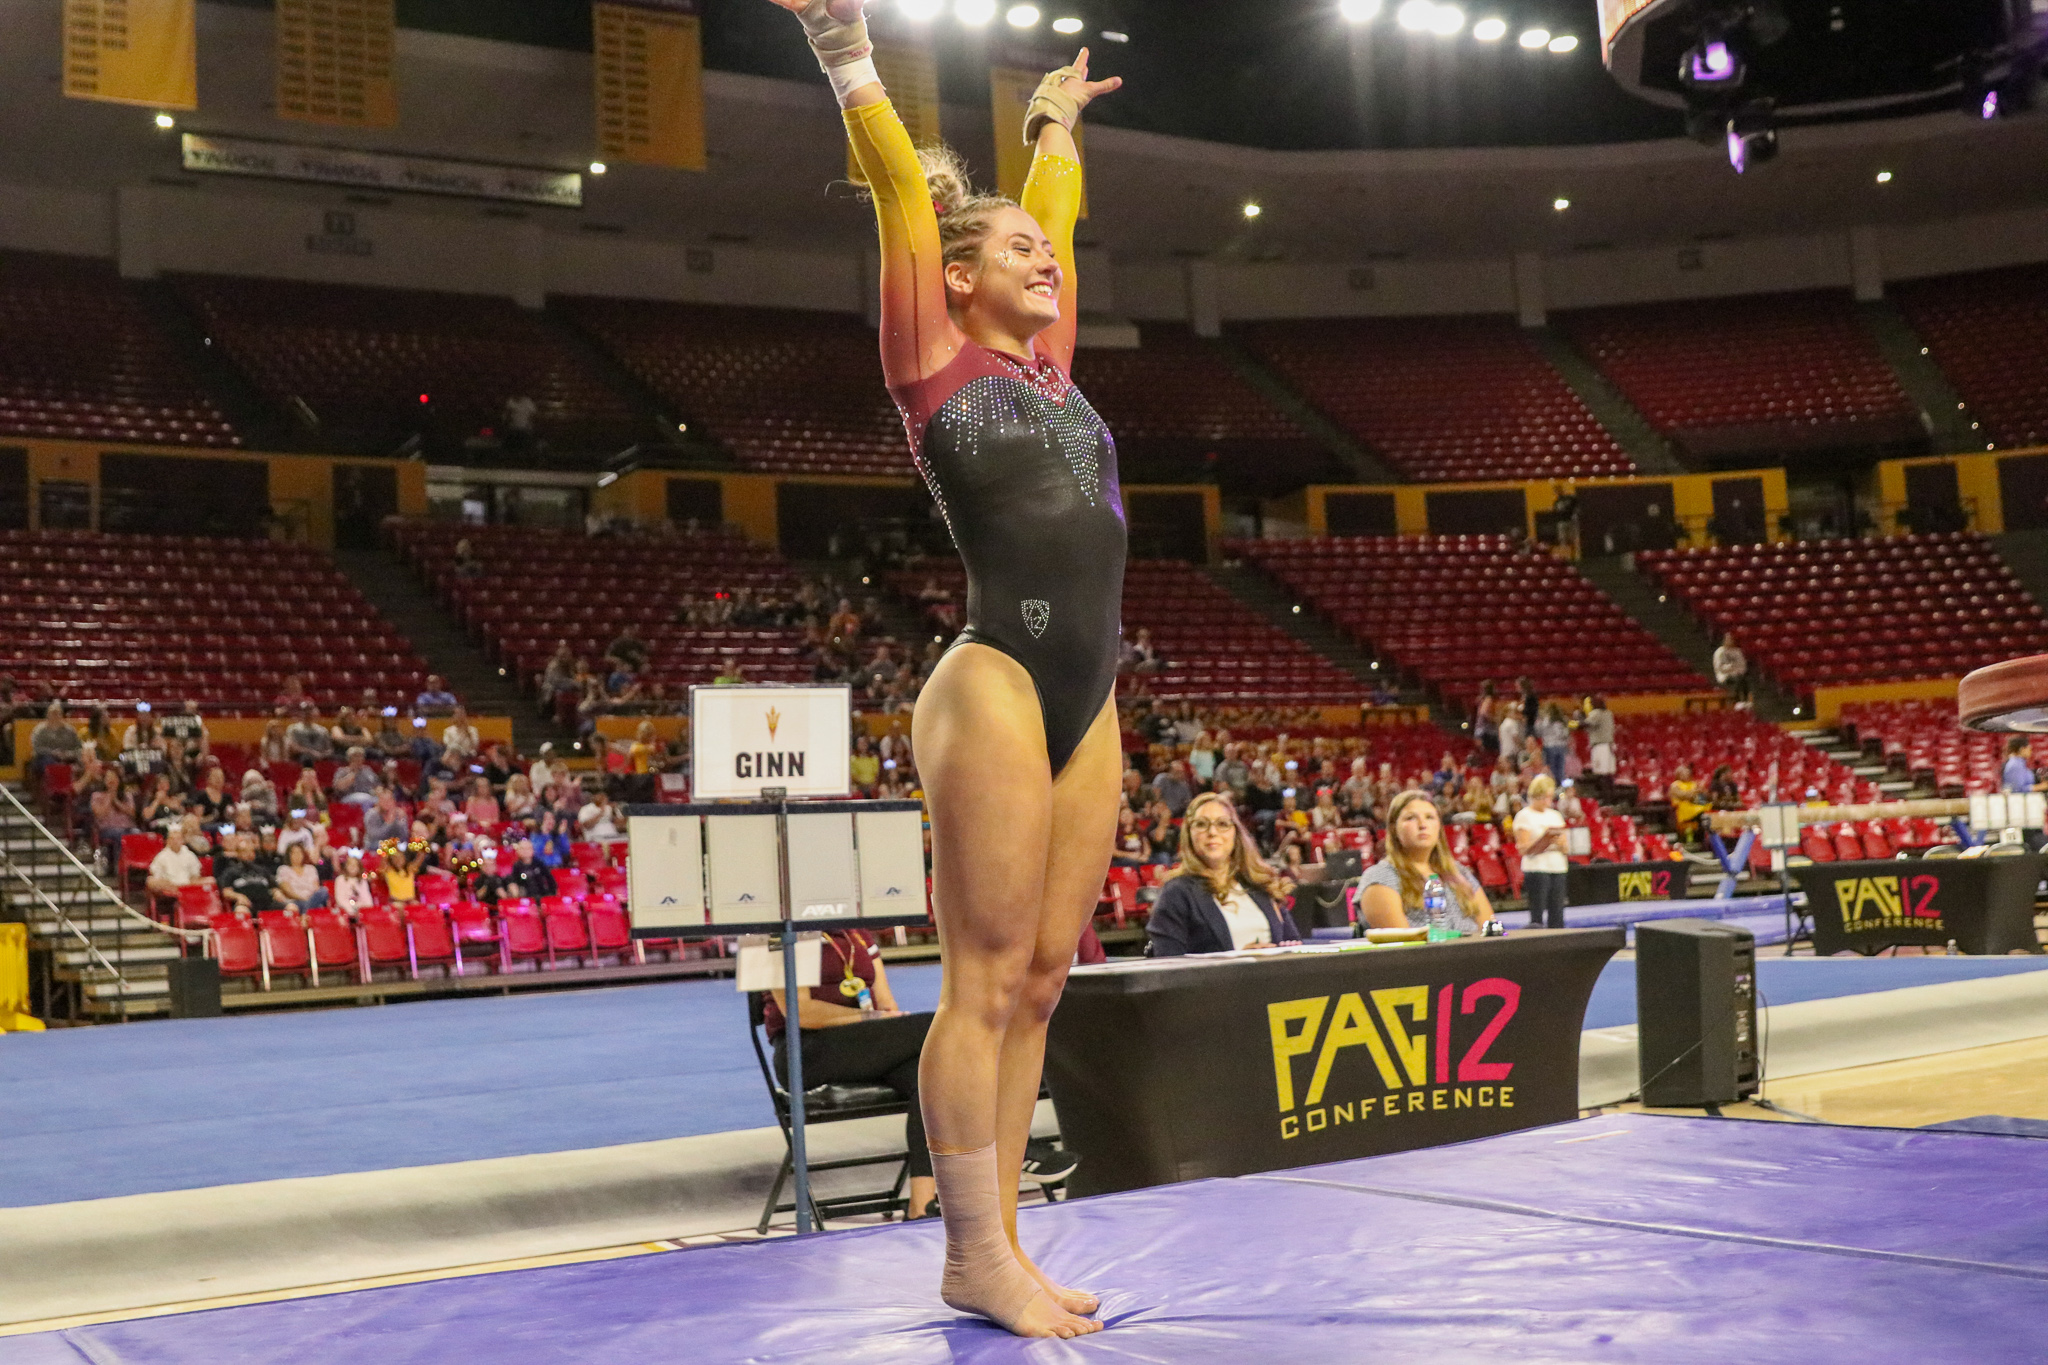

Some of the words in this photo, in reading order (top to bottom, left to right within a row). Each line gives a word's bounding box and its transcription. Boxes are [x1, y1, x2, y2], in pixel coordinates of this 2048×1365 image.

[735, 752, 805, 778] GINN
[1843, 917, 1945, 934] CONFERENCE
[1281, 1086, 1515, 1140] CONFERENCE
